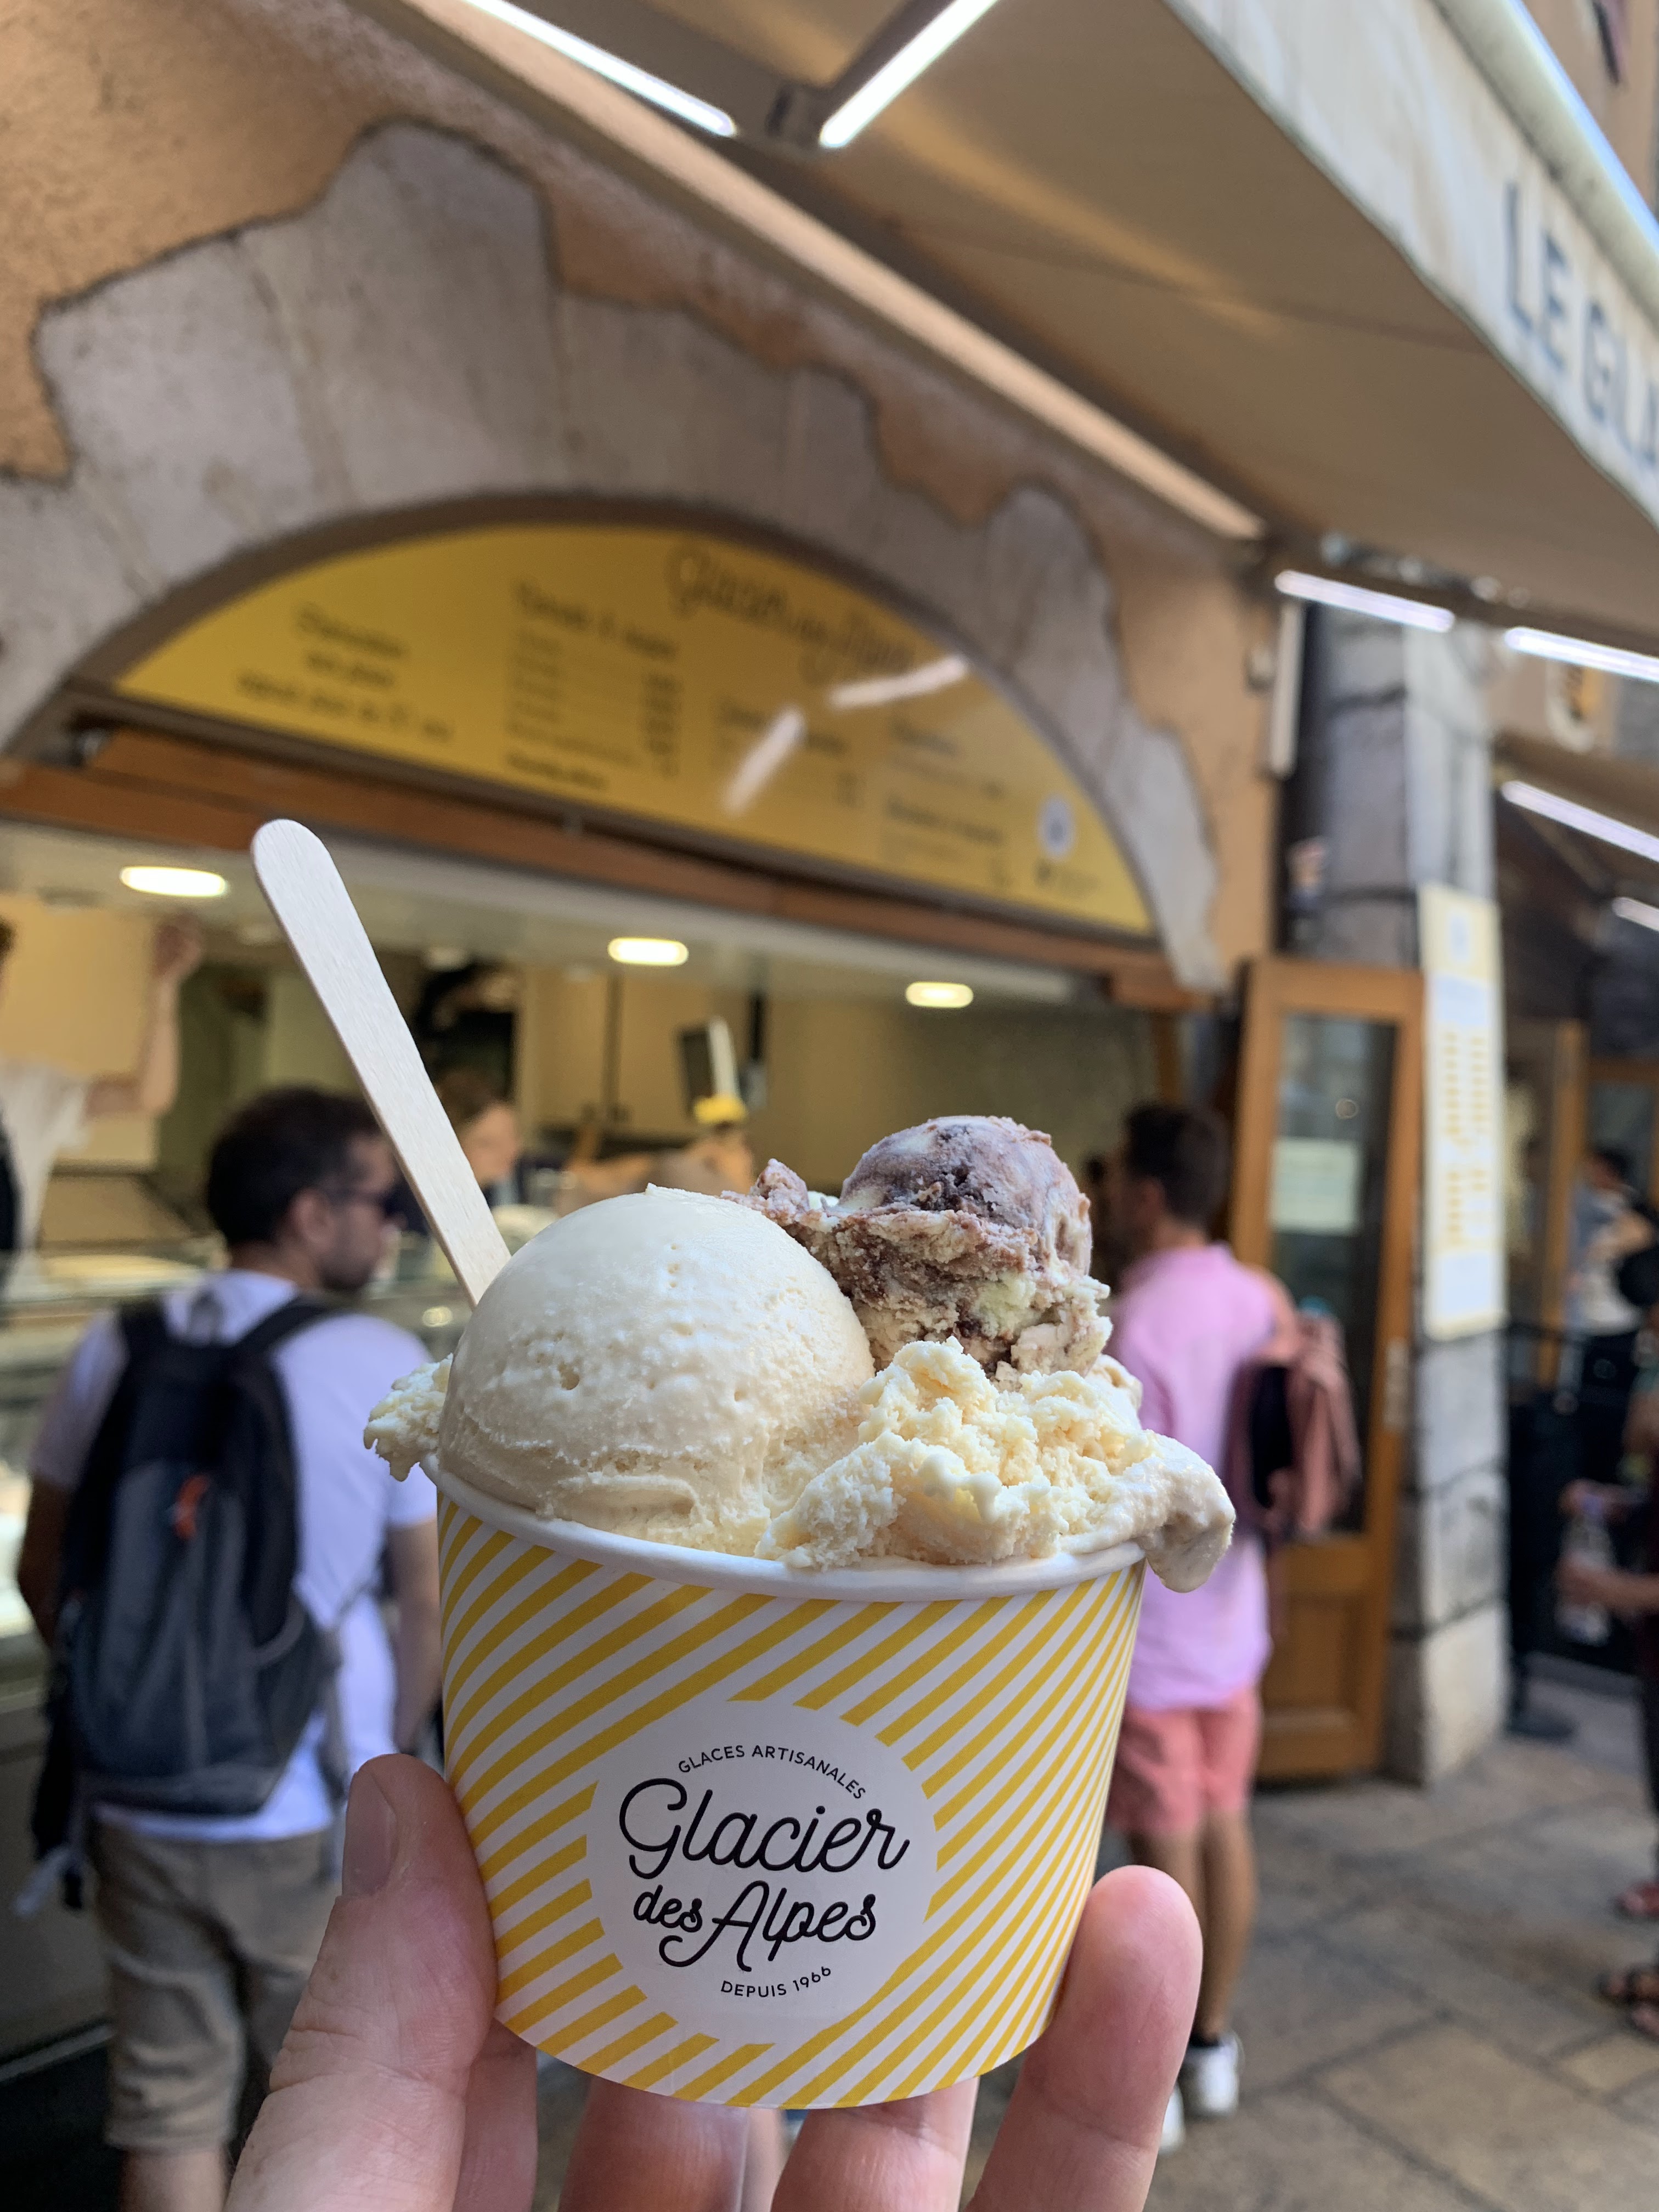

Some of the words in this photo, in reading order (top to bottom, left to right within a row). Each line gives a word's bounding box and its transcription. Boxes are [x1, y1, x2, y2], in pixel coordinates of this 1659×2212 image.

[1503, 180, 1567, 374] LE
[678, 1745, 745, 1773] GLACES
[751, 1745, 866, 1799] ARTISANALES
[619, 1778, 911, 1880] Glacier
[633, 1884, 703, 1933] des
[658, 1880, 876, 1972] Alpes
[720, 1980, 787, 1998] DEPUIS
[792, 1966, 831, 1992] 1966
